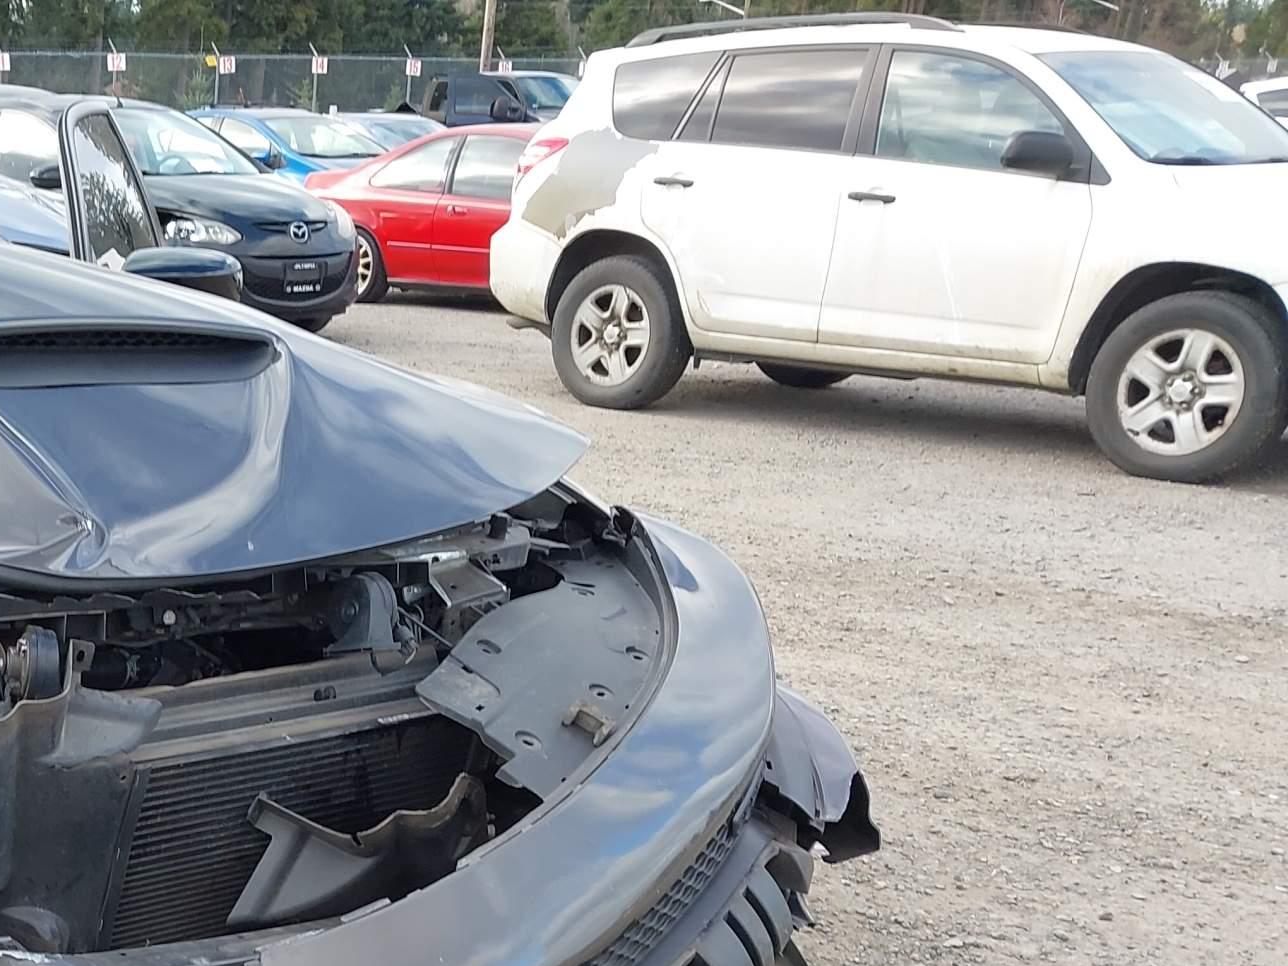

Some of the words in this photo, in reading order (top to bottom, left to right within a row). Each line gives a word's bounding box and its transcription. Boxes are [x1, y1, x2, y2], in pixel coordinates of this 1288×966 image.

[111, 54, 122, 70] 12
[223, 56, 233, 72] 13
[315, 57, 325, 73] 14
[293, 284, 314, 292] MAZDA
